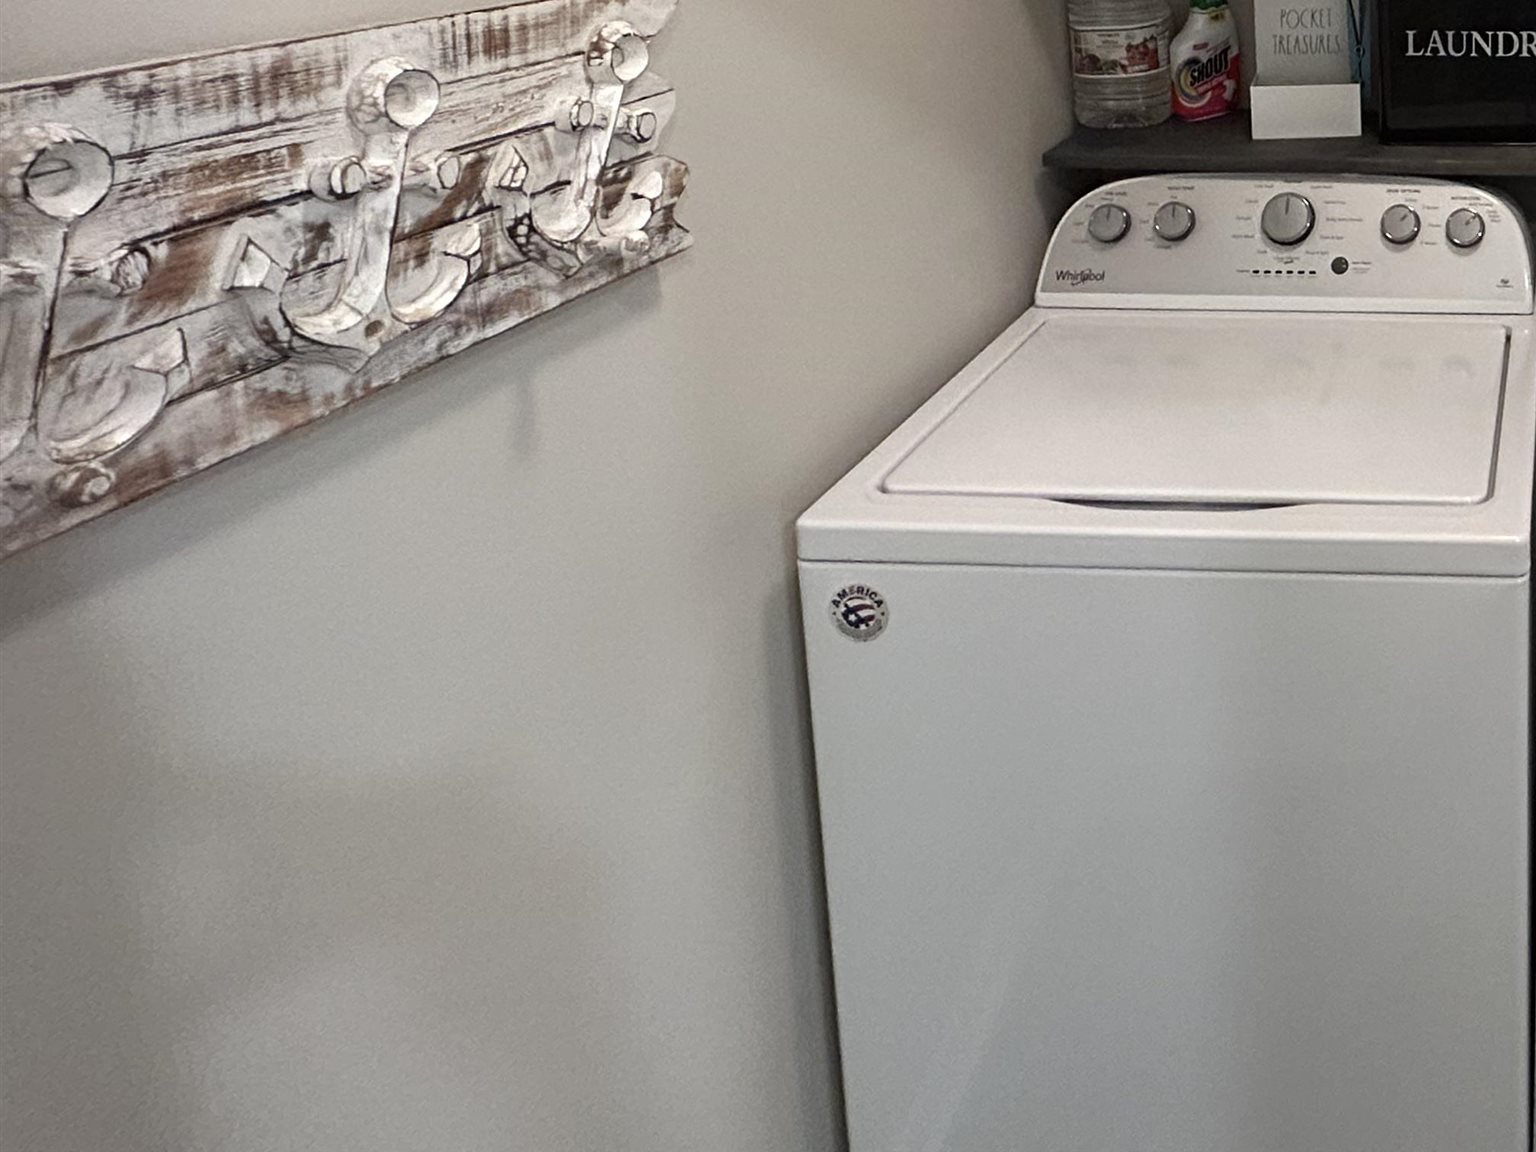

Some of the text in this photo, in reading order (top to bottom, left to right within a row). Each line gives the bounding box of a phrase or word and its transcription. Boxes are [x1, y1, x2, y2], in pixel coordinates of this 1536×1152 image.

[1280, 8, 1332, 30] POCKET
[1271, 33, 1341, 56] TREASURES
[1055, 268, 1106, 286] Whirlpool
[831, 584, 884, 609] AMERICA
